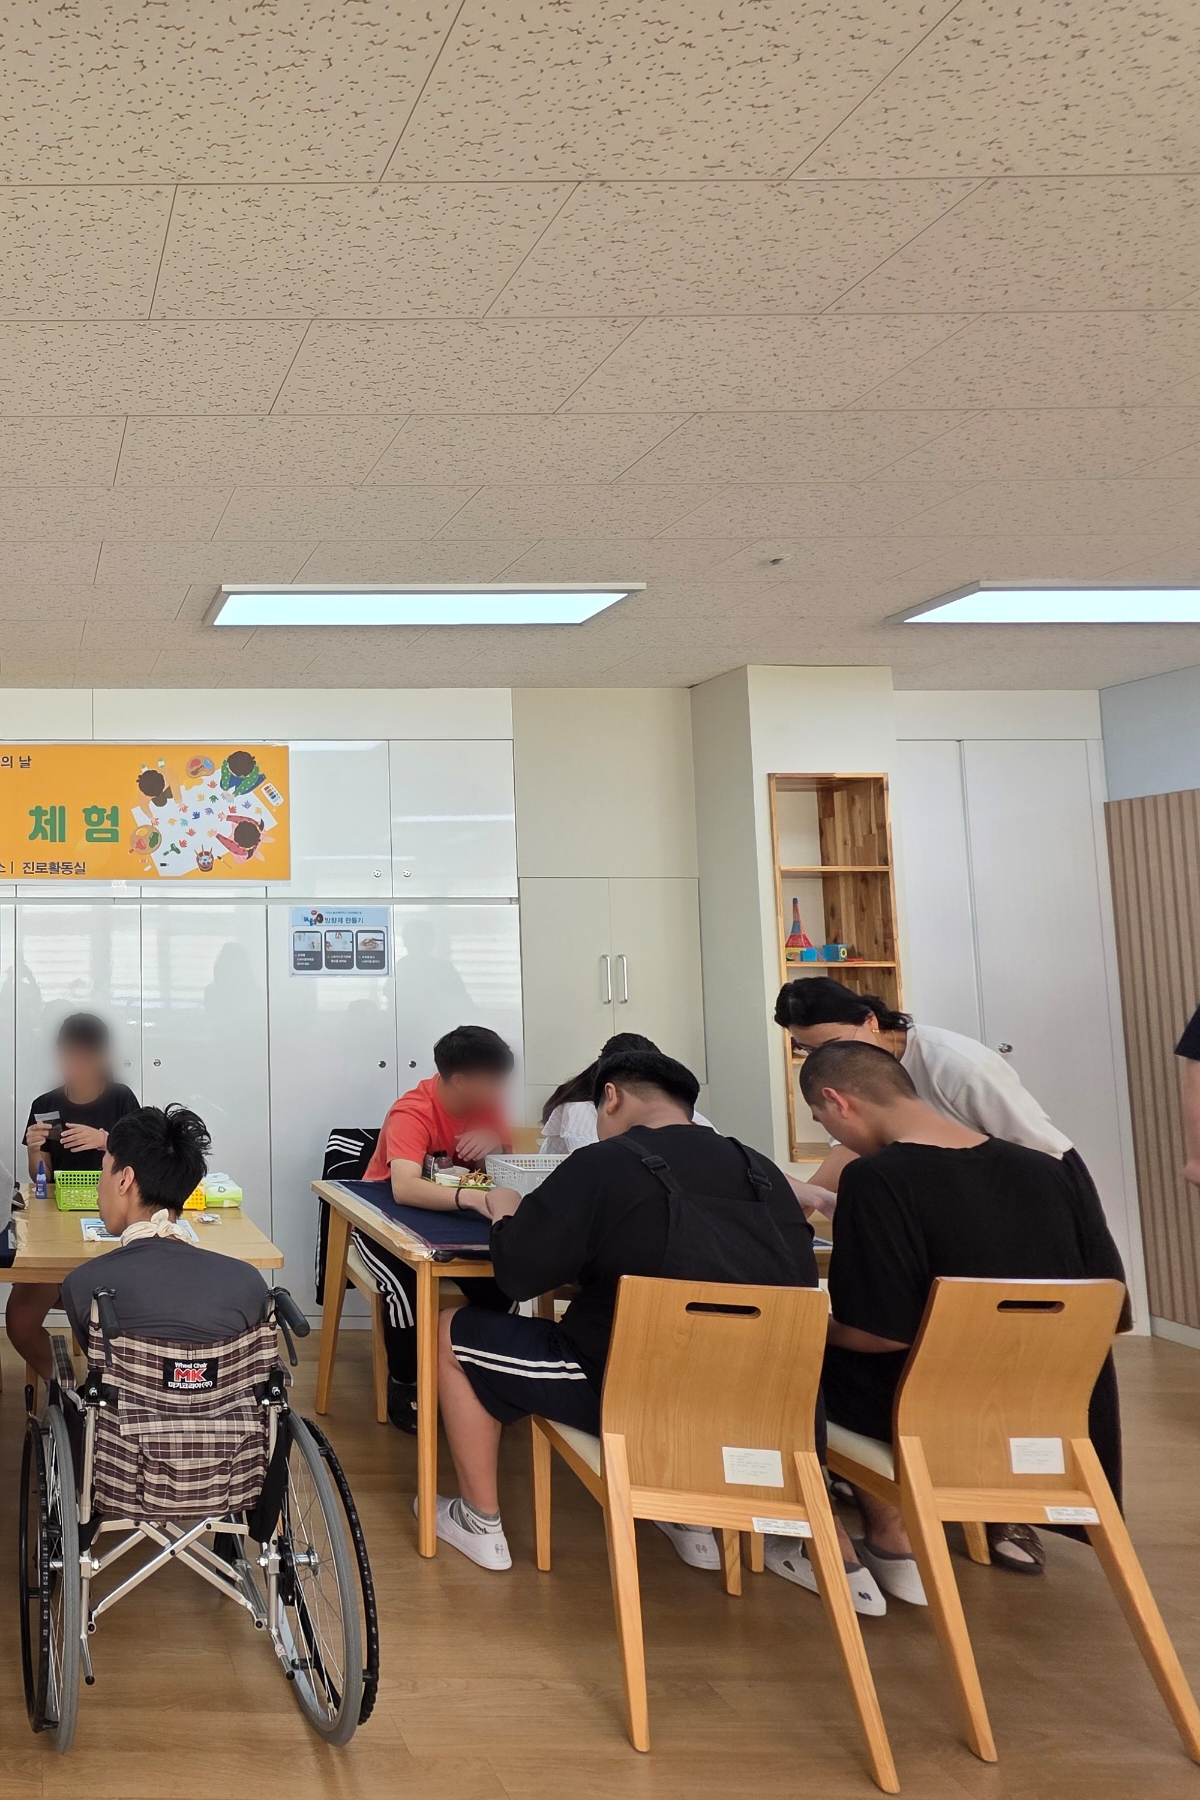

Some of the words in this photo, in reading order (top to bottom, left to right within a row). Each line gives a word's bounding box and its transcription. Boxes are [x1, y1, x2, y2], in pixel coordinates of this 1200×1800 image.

[19, 755, 32, 769] 날
[28, 804, 120, 843] 체험
[22, 860, 86, 875] 진로활동실
[174, 1368, 207, 1382] MK
